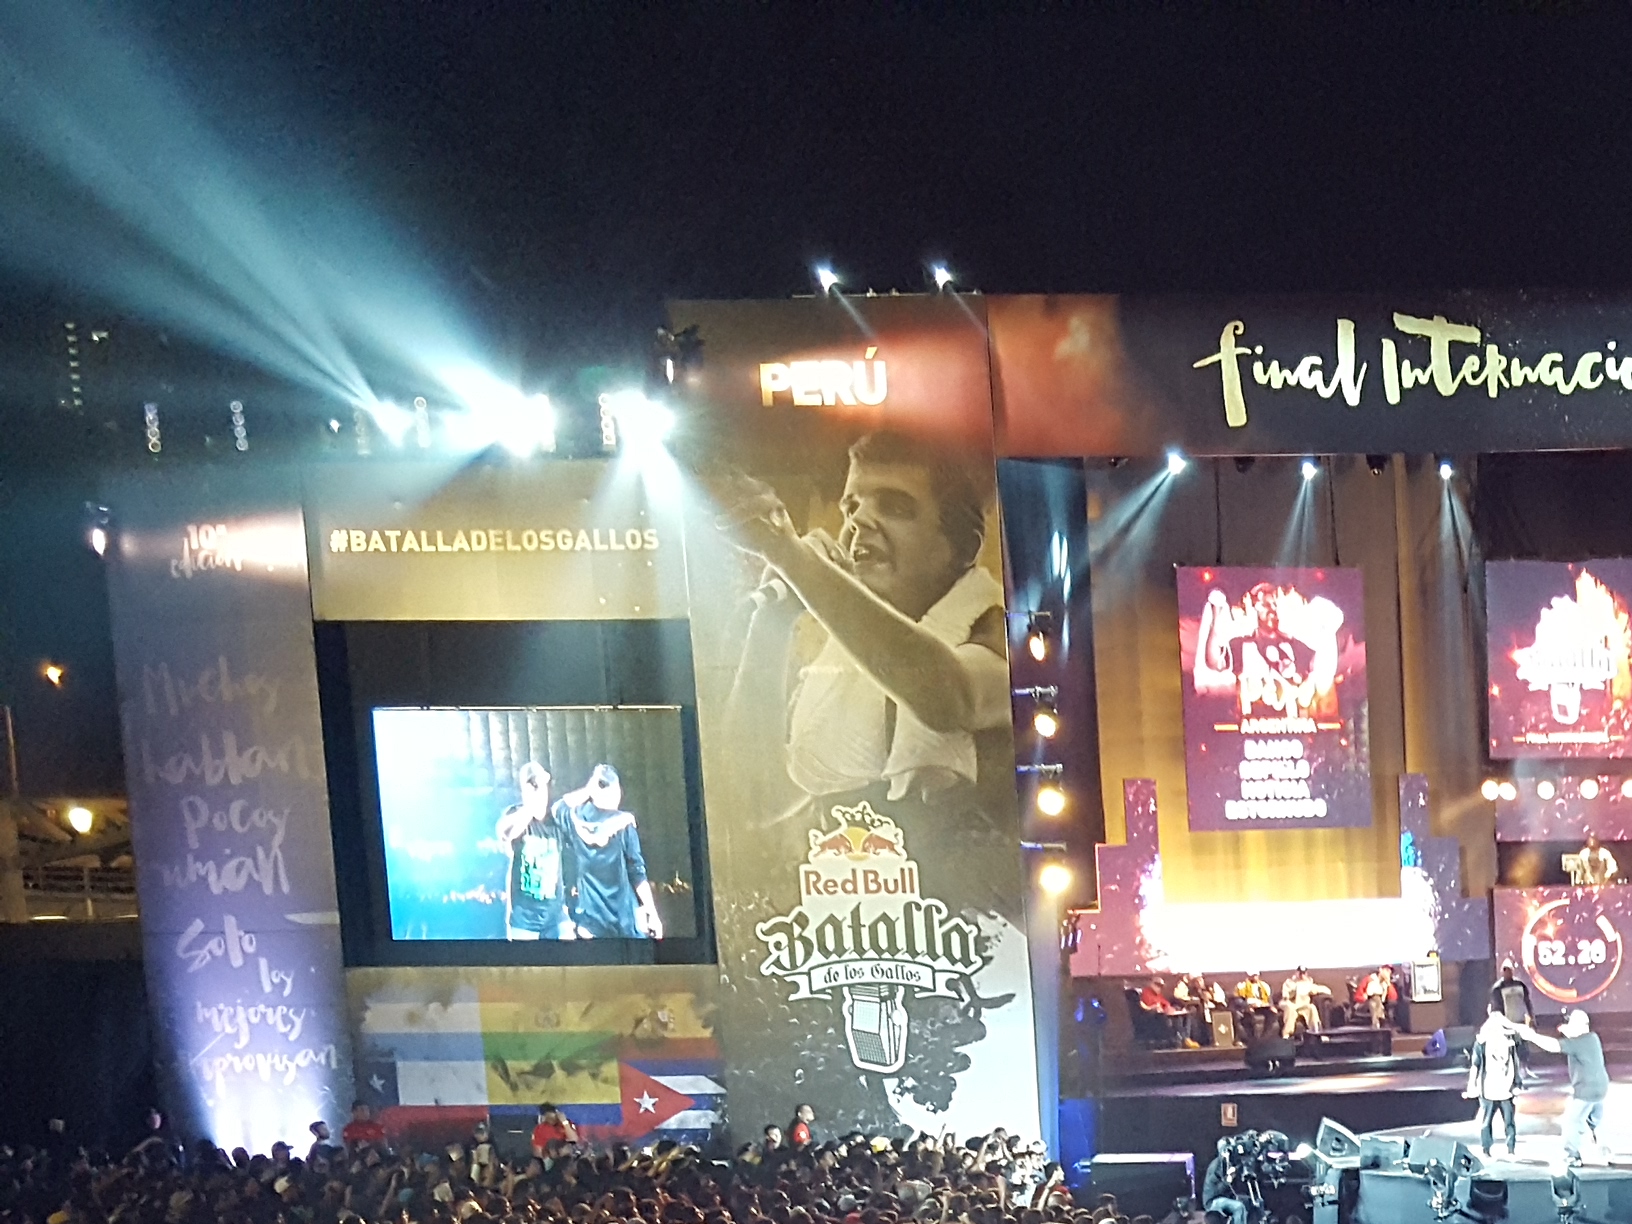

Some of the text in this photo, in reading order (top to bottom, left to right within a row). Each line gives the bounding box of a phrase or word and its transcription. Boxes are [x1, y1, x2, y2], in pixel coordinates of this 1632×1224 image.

[759, 346, 888, 407] PERÚ
[329, 527, 660, 553] #BATALLADELOSGALLOS
[803, 867, 916, 896] Red Bull
[176, 914, 257, 973] Solo
[758, 900, 979, 972] Batalla
[259, 957, 295, 997] los
[823, 962, 922, 984] de los Gallos
[196, 998, 306, 1050] mejores
